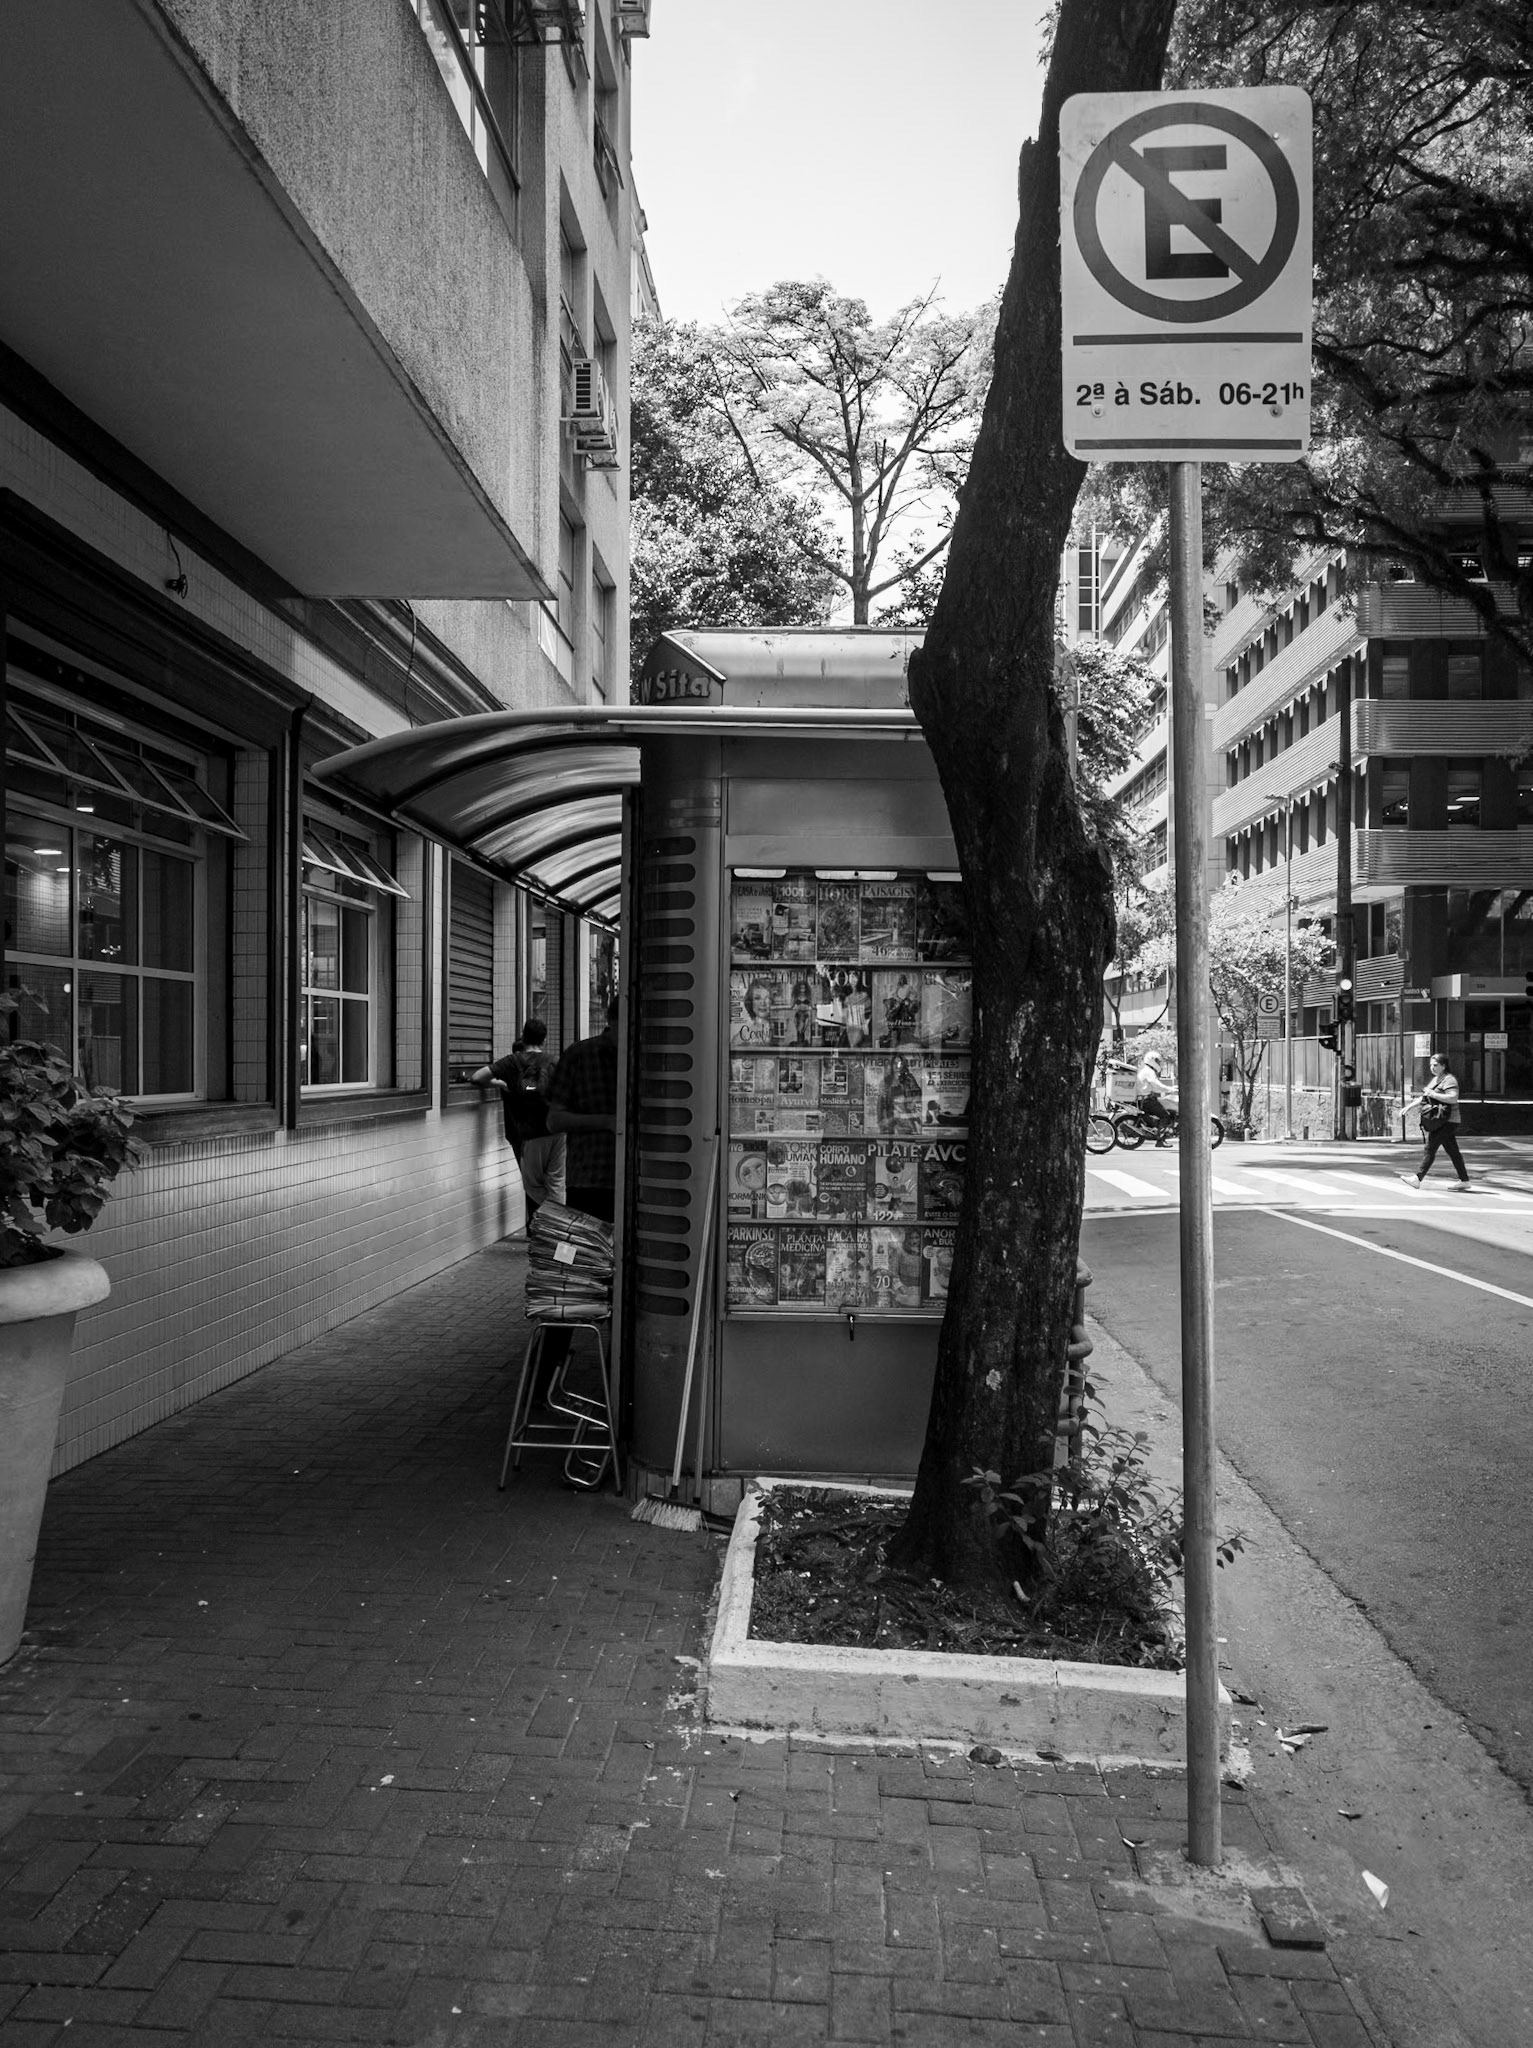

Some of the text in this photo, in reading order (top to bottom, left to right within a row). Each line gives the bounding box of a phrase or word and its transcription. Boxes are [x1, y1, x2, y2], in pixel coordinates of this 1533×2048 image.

[1143, 144, 1229, 280] E
[1075, 380, 1304, 406] 2ª à Sáb. 06-21h
[820, 1145, 849, 1154] CORPO
[867, 1144, 921, 1157] PILATE
[923, 1144, 966, 1162] AVC
[820, 1153, 866, 1165] HUMANO
[875, 1275, 890, 1288] 70
